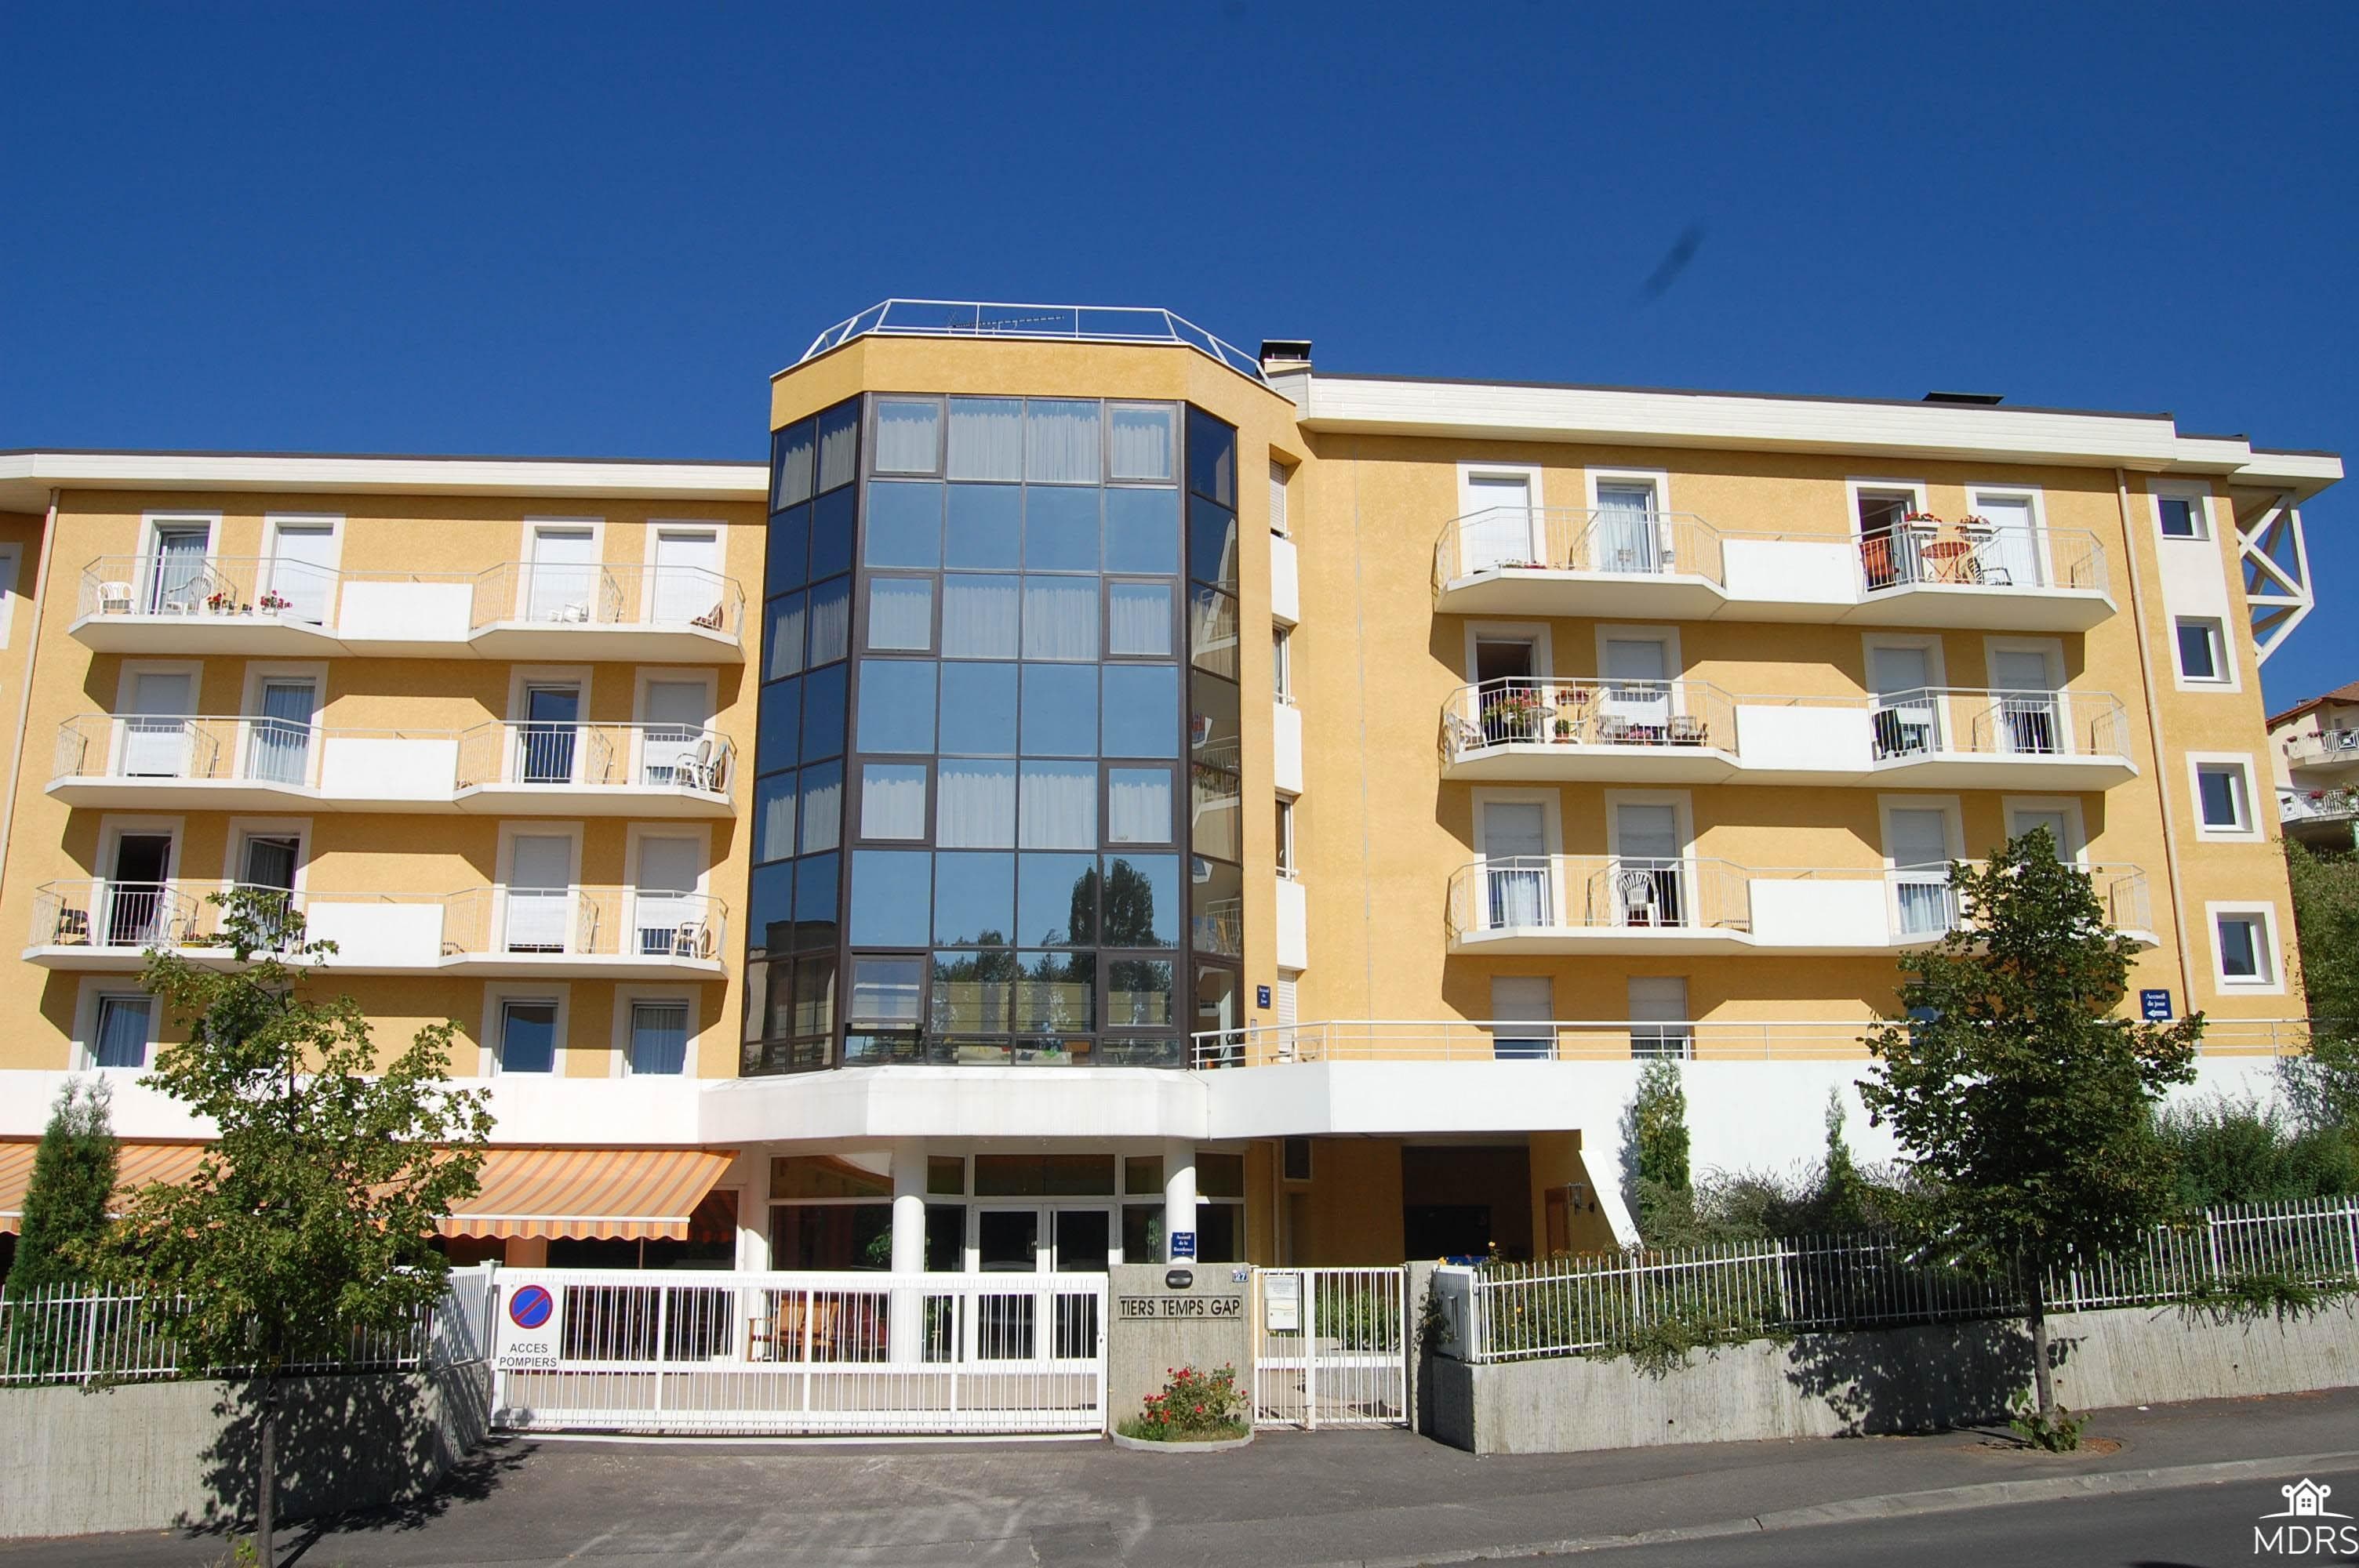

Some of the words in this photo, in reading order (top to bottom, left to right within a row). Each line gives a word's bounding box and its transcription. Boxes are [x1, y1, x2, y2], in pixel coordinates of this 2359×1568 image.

[1121, 1299, 1154, 1316] TIERS
[1161, 1299, 1204, 1316] TEMPS
[1210, 1299, 1240, 1316] GAP
[510, 1343, 548, 1353] ACCES
[500, 1356, 557, 1367] POMPIERS
